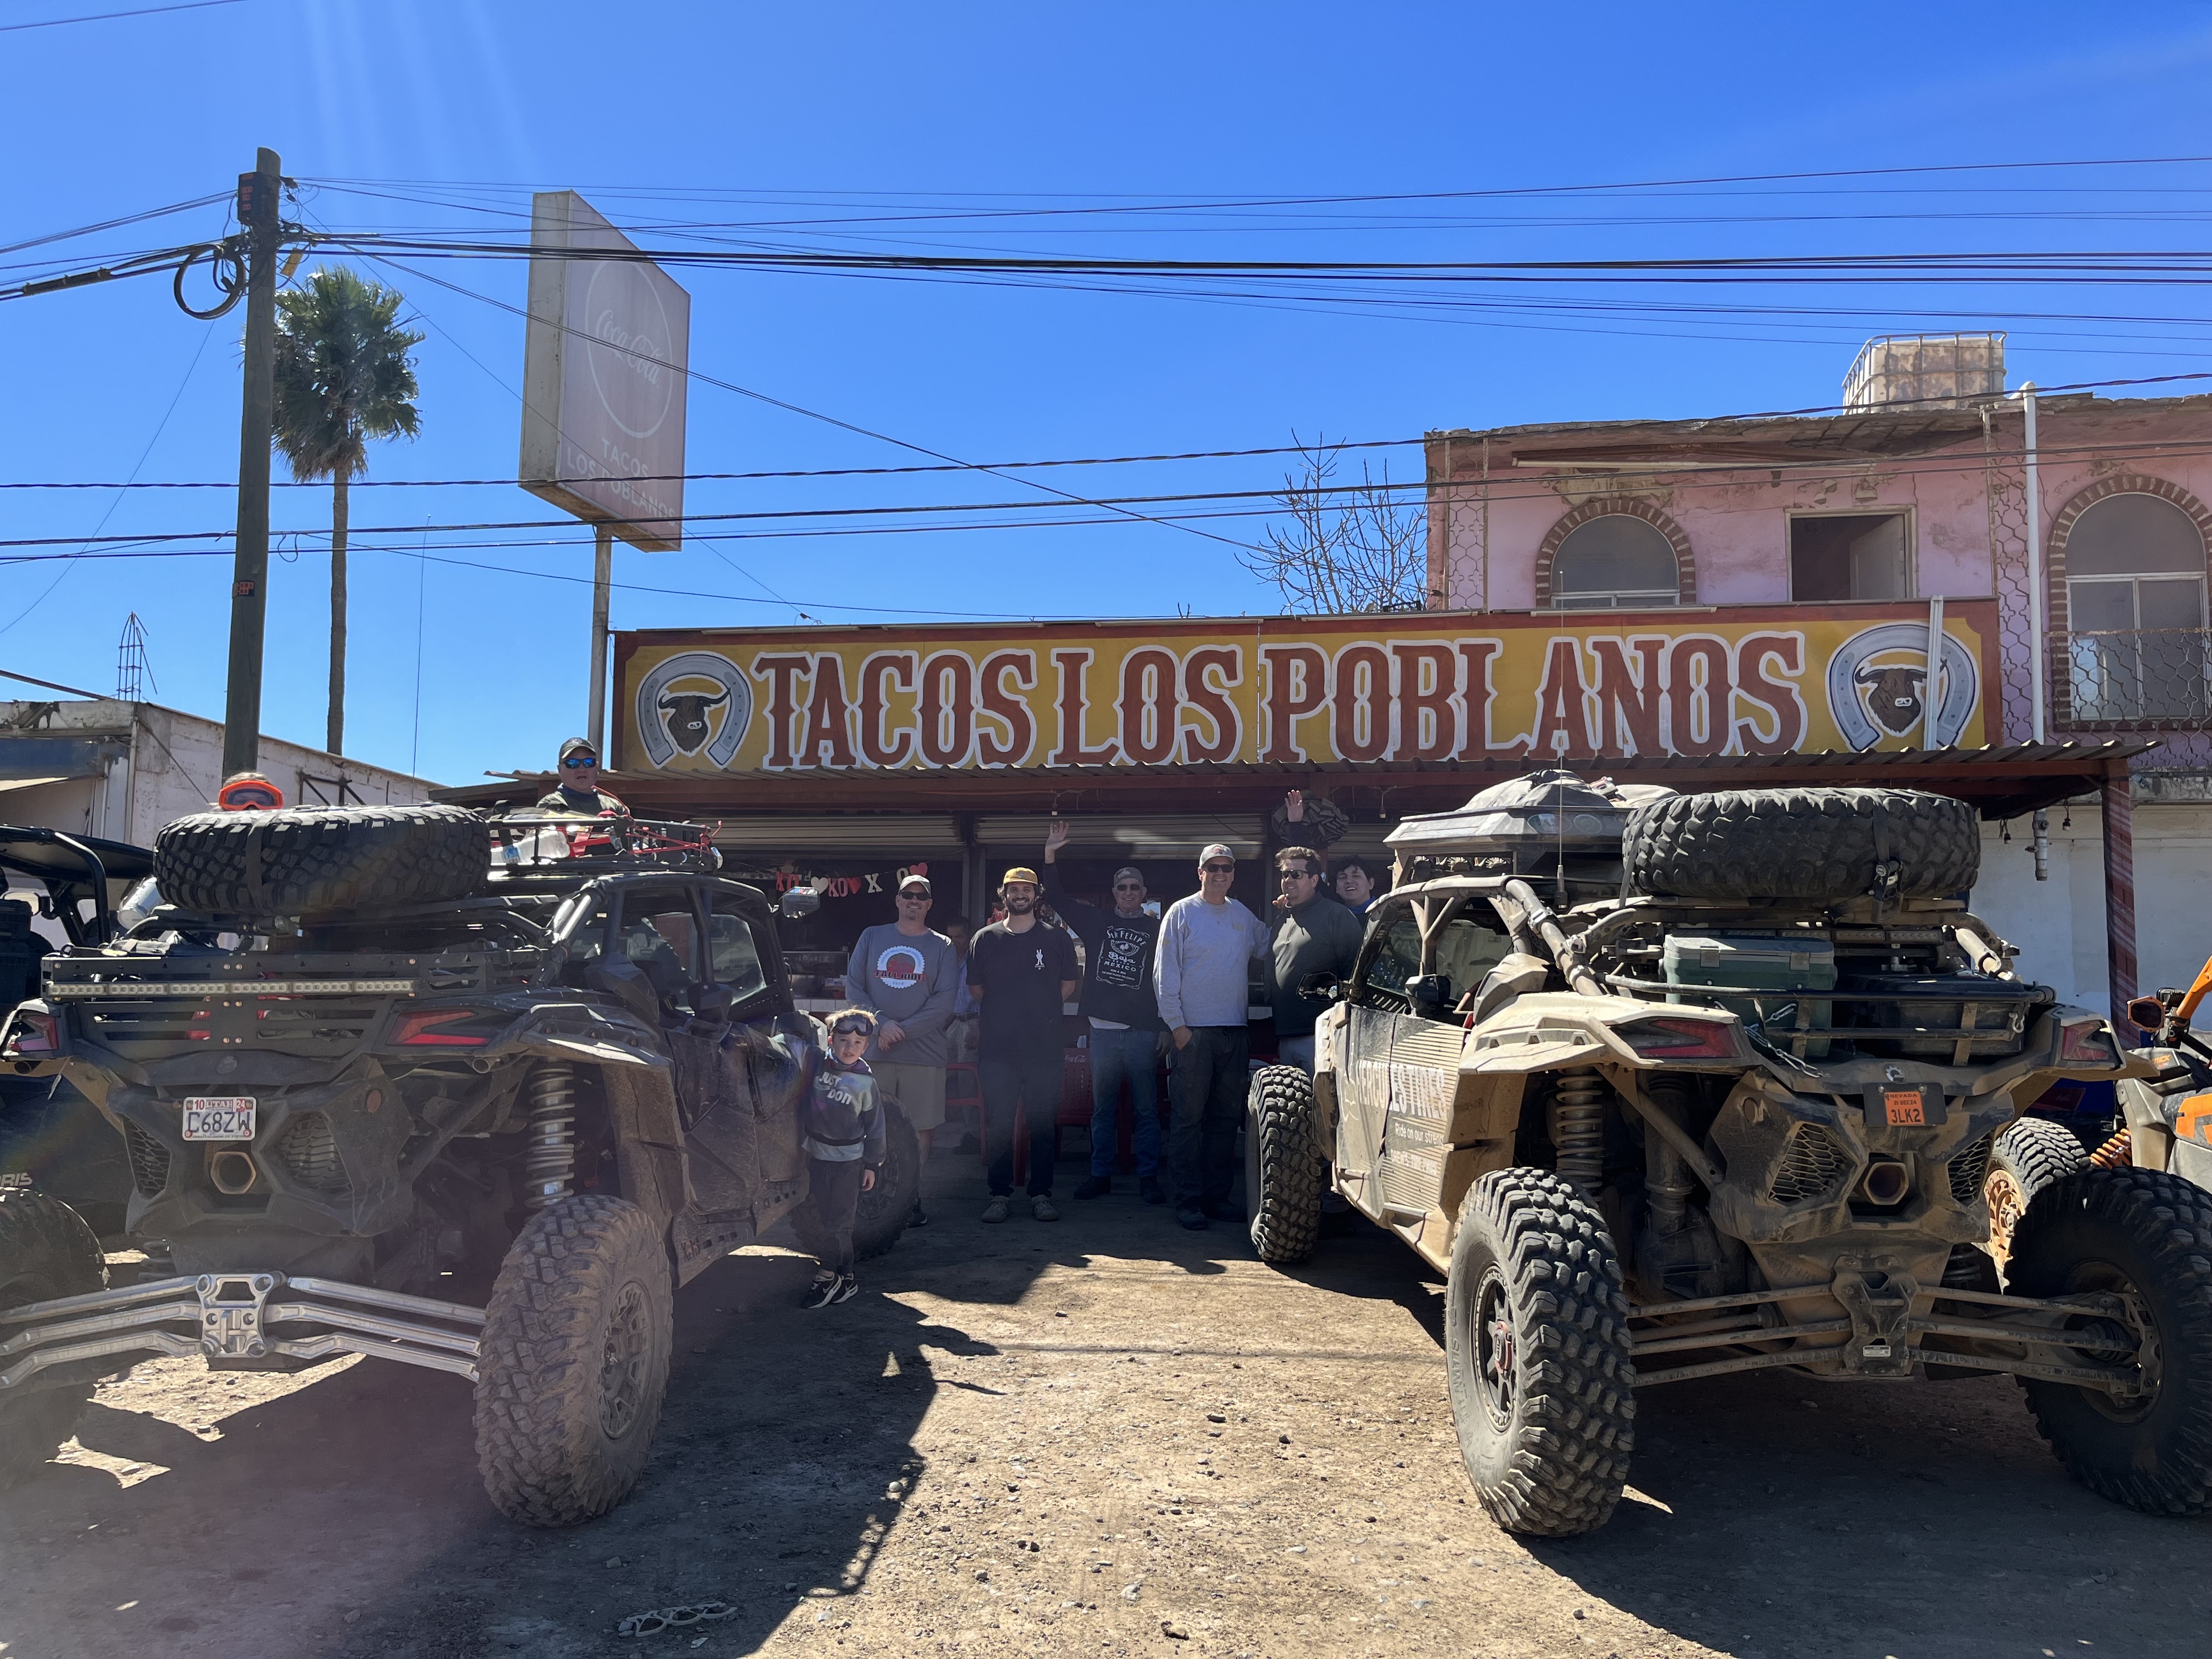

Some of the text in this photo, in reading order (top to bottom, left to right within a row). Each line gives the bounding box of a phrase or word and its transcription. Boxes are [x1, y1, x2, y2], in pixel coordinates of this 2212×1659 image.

[602, 437, 649, 483] TACOS
[567, 445, 675, 527] LOS POBLANOS
[751, 630, 1808, 769] TACOS LOS POBLANOS
[1120, 930, 1147, 946] FELIPE
[1108, 951, 1136, 963] Baja
[1104, 961, 1137, 972] MEXICO
[1406, 1066, 1448, 1120] TIRES
[194, 1099, 205, 1110] 10
[236, 1099, 246, 1109] 24
[188, 1111, 251, 1133] C68ZW
[1891, 1108, 1921, 1124] 3LK2
[1395, 1122, 1407, 1137] Ride
[1407, 1128, 1414, 1138] on
[1414, 1130, 1424, 1142] our
[0, 1172, 33, 1187] RIS
